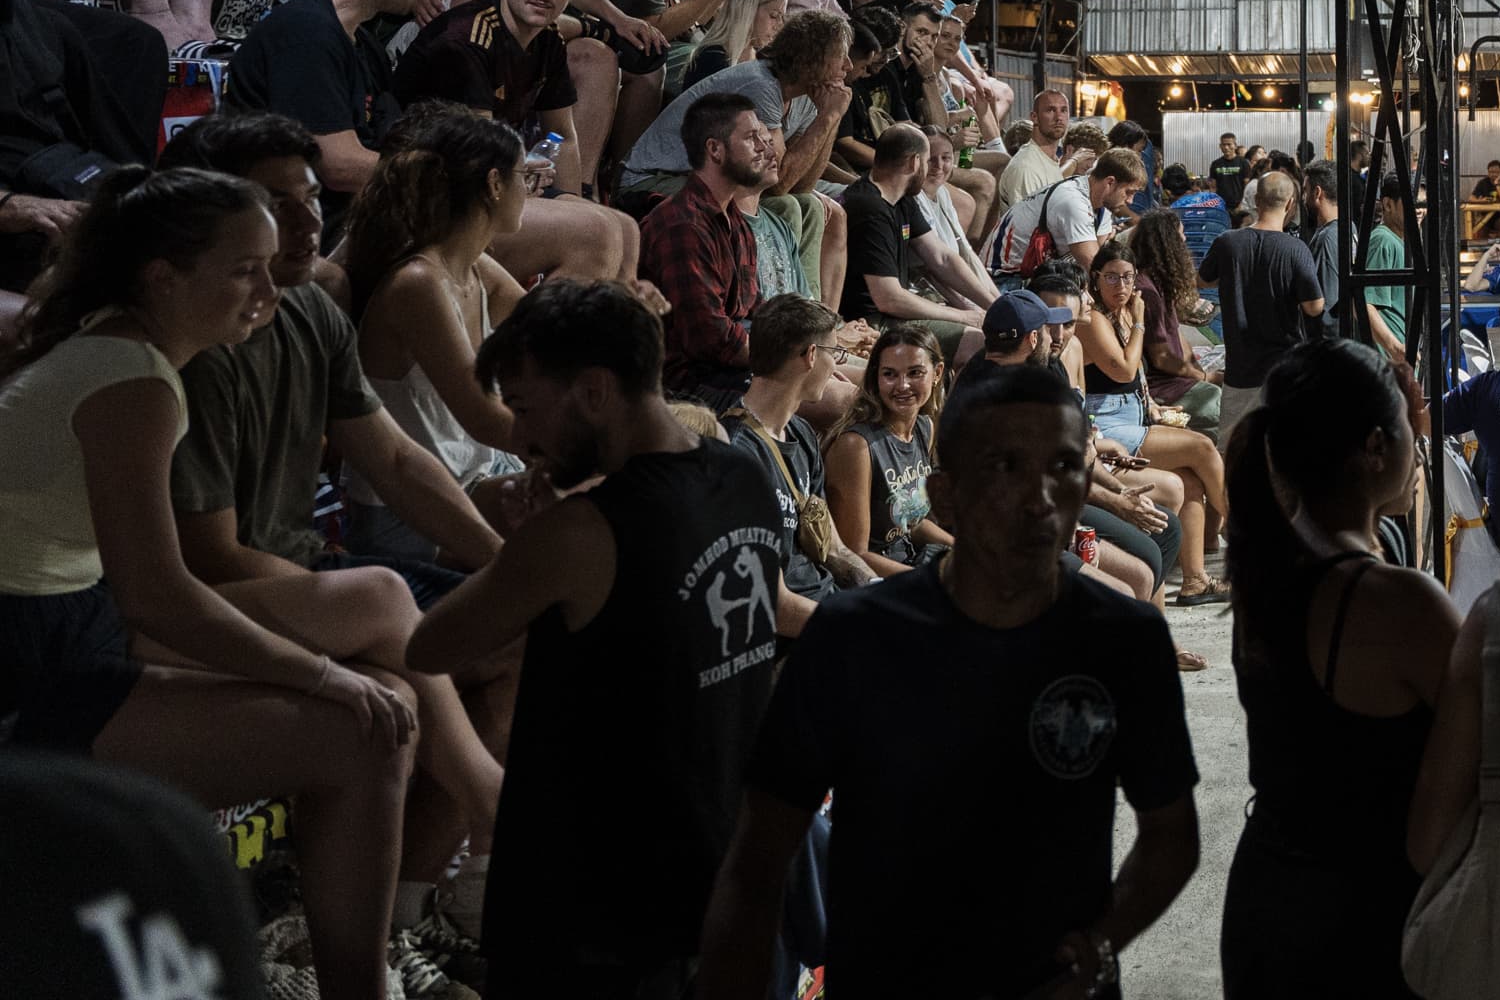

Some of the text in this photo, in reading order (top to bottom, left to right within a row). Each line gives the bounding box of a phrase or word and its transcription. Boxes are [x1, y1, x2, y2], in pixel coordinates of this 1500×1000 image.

[728, 527, 782, 559] MUAYTHA
[697, 640, 777, 690] KOH PHANG
